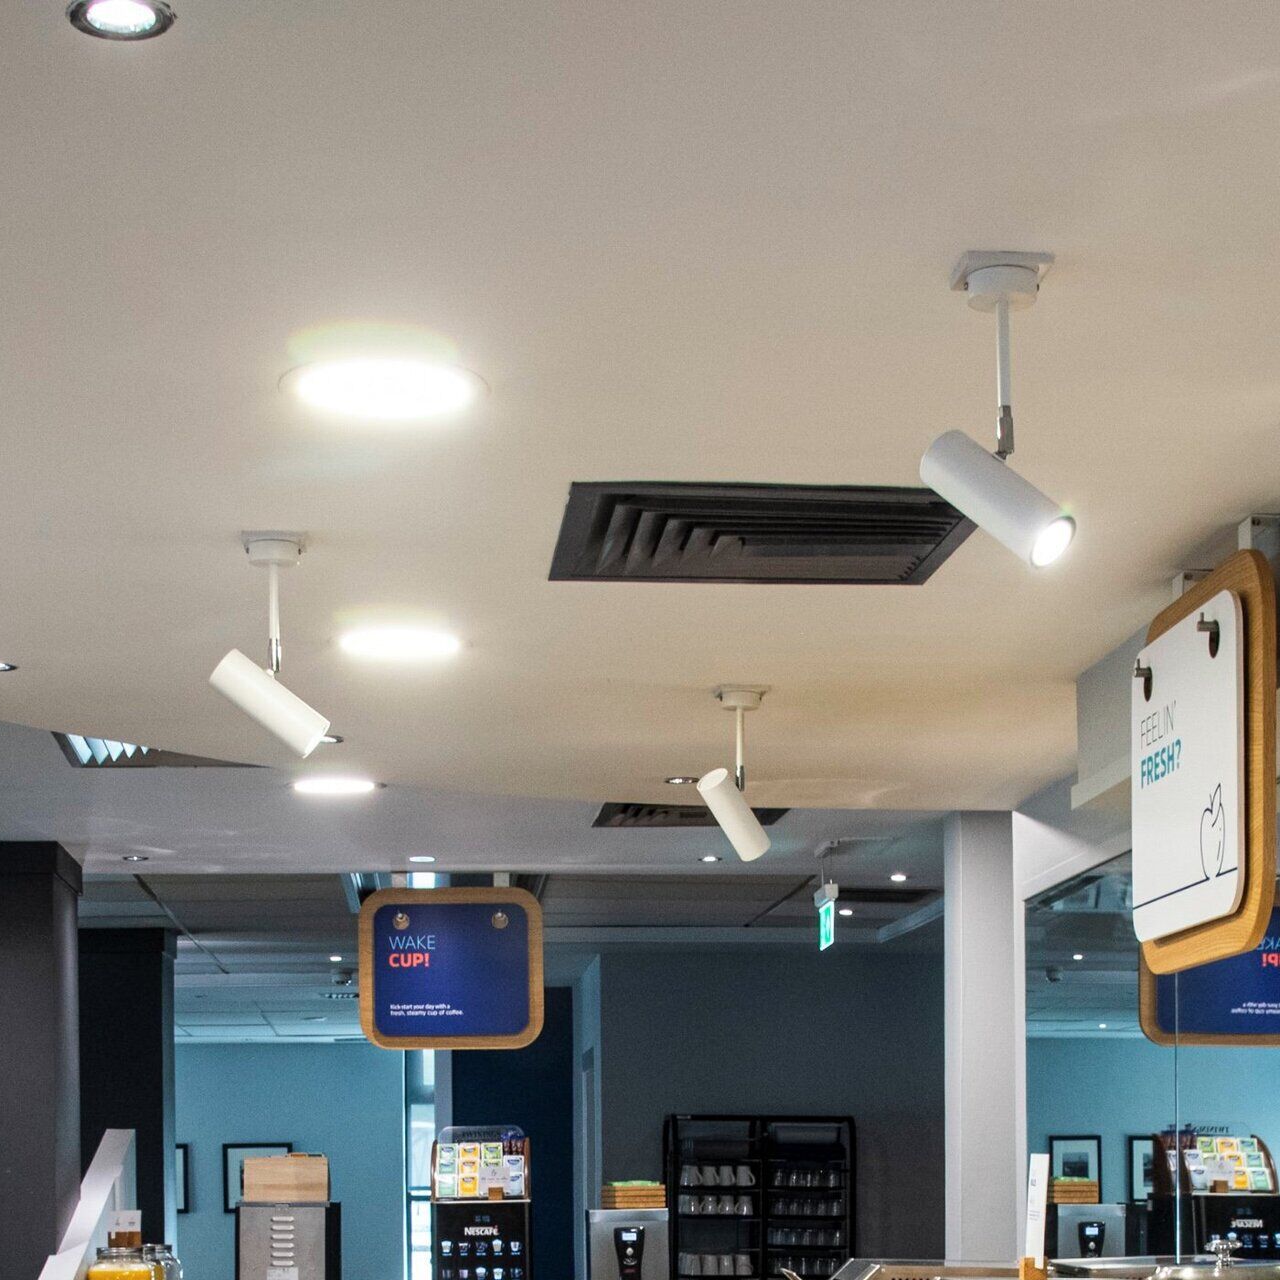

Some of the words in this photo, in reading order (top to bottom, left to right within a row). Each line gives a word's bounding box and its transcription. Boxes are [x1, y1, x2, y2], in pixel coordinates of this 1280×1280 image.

[1141, 738, 1181, 790] FRESH?
[388, 934, 436, 950] WAKE
[388, 952, 430, 968] CUP!
